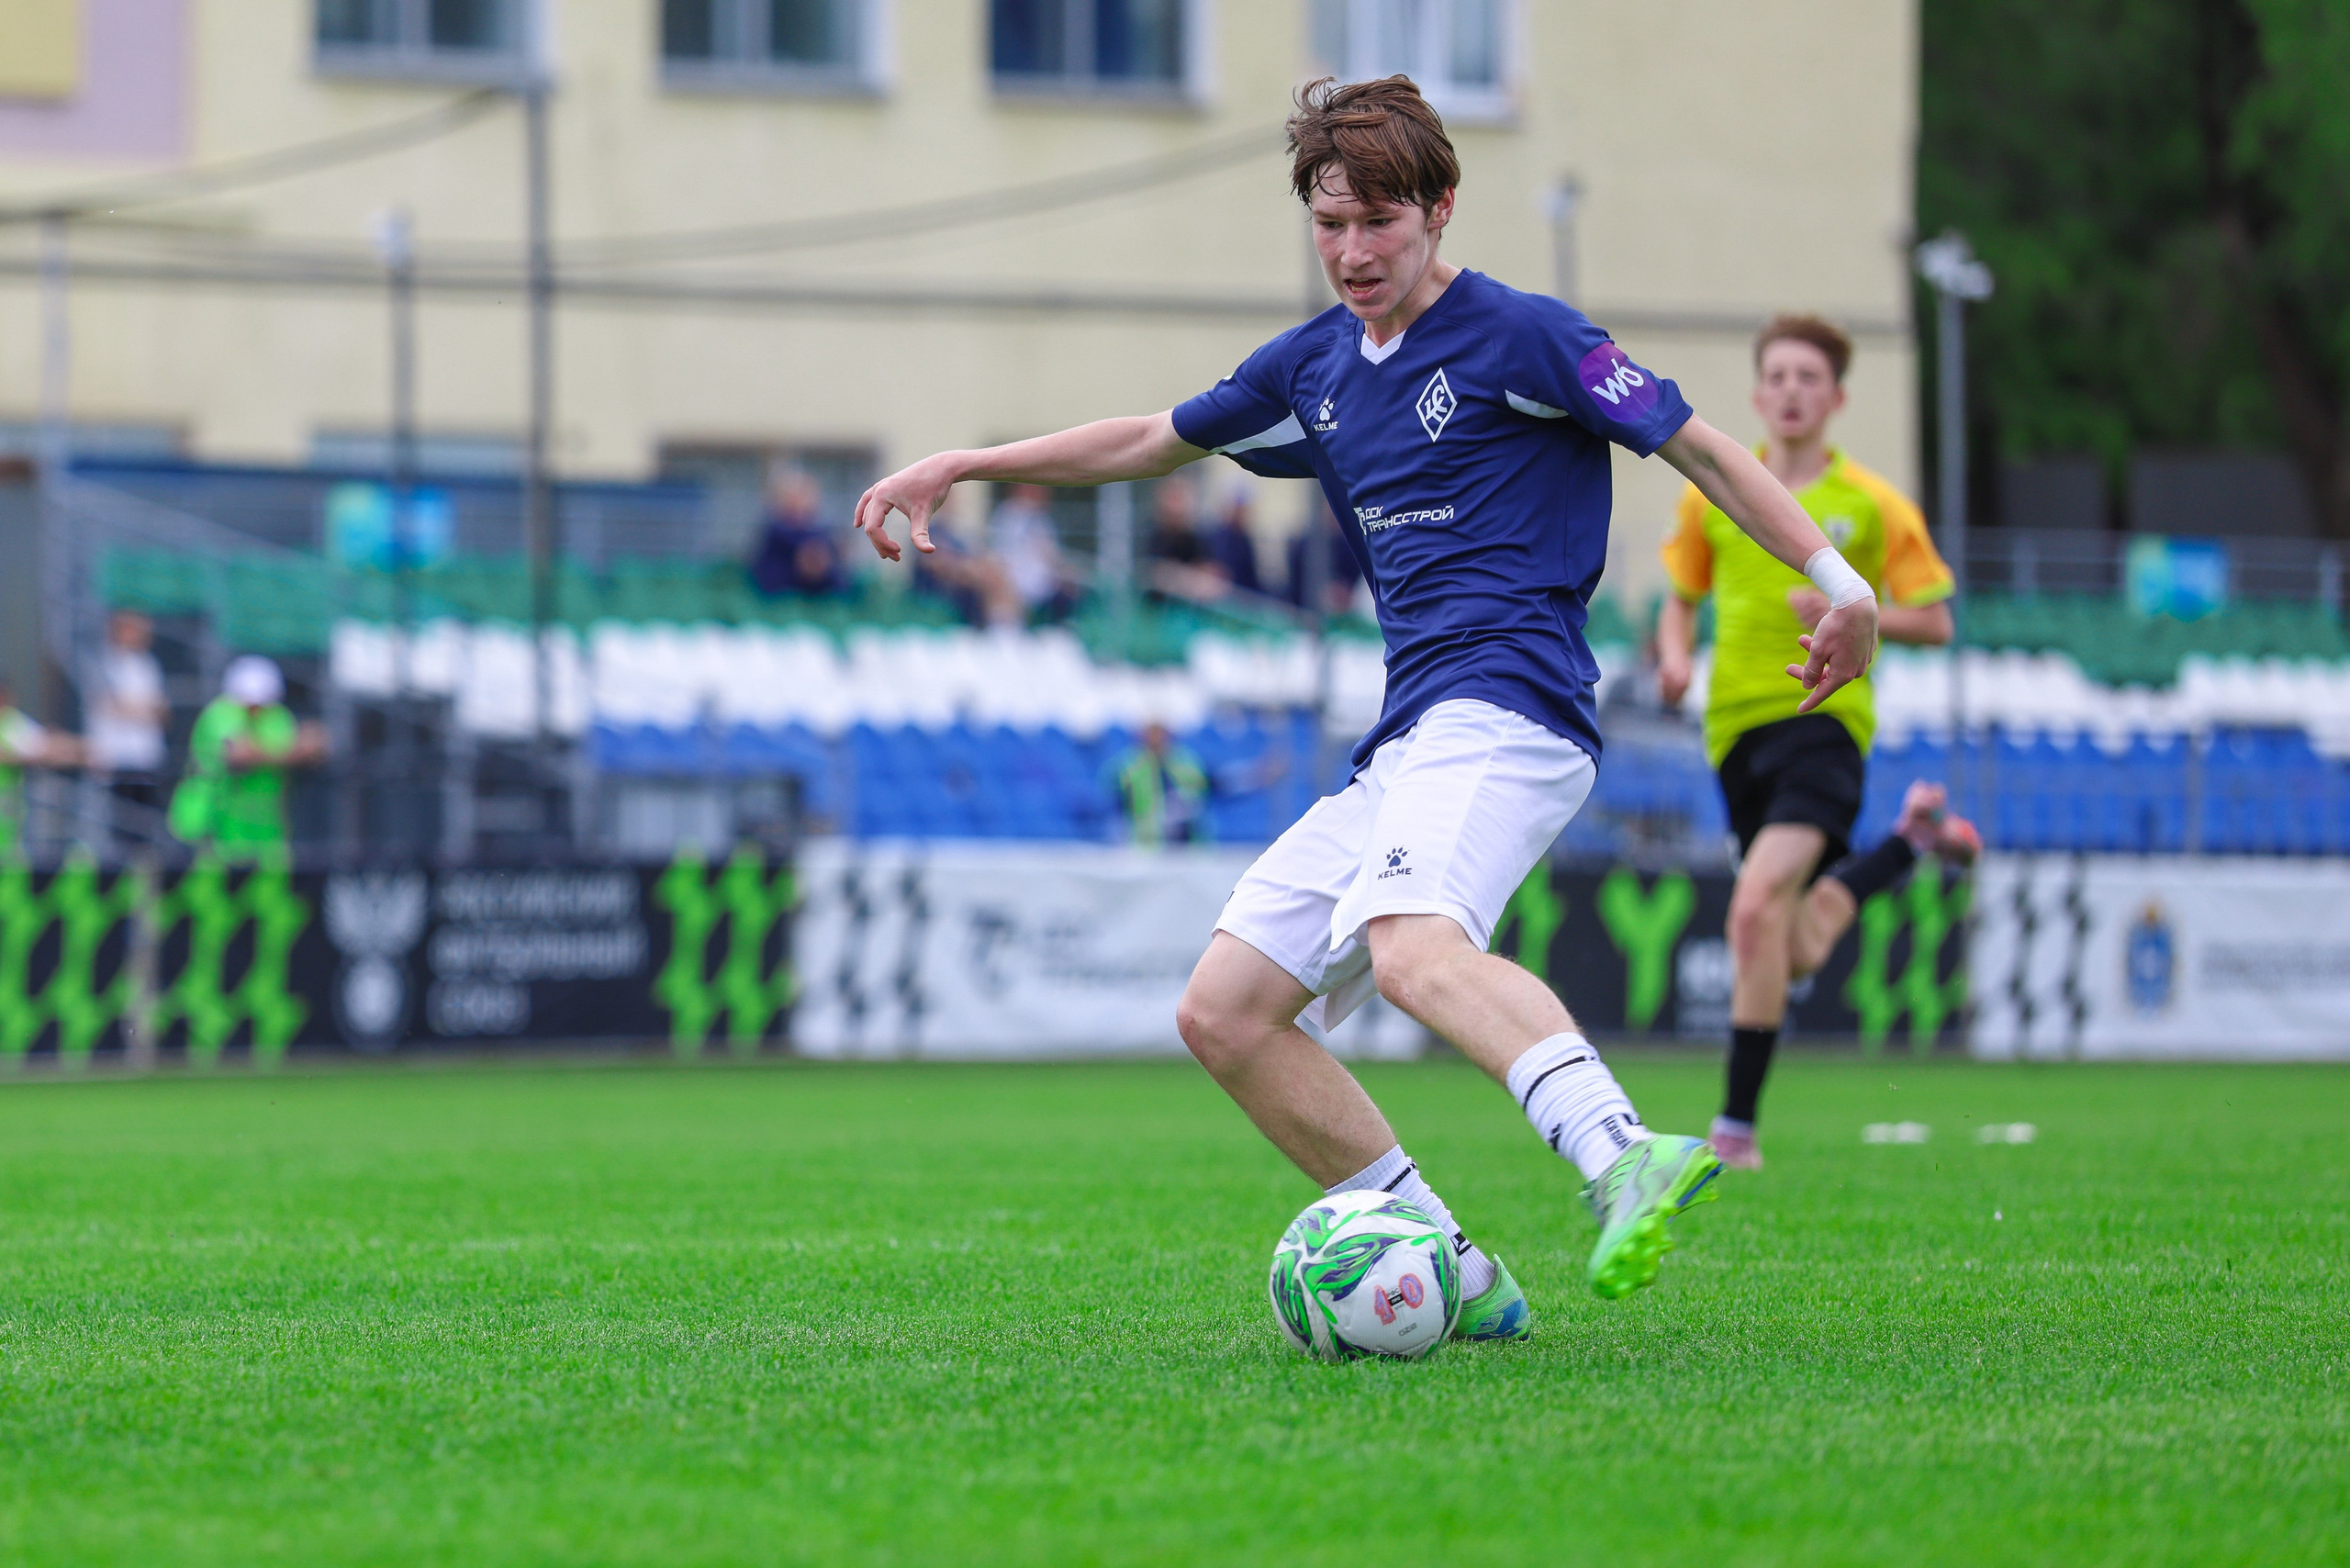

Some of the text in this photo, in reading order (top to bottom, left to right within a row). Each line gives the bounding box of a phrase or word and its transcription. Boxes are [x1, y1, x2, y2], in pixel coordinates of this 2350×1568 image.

[1313, 420, 1339, 431] KELME
[1367, 505, 1455, 532] ТРАНССТРОЙ
[1377, 868, 1413, 880] KELME
